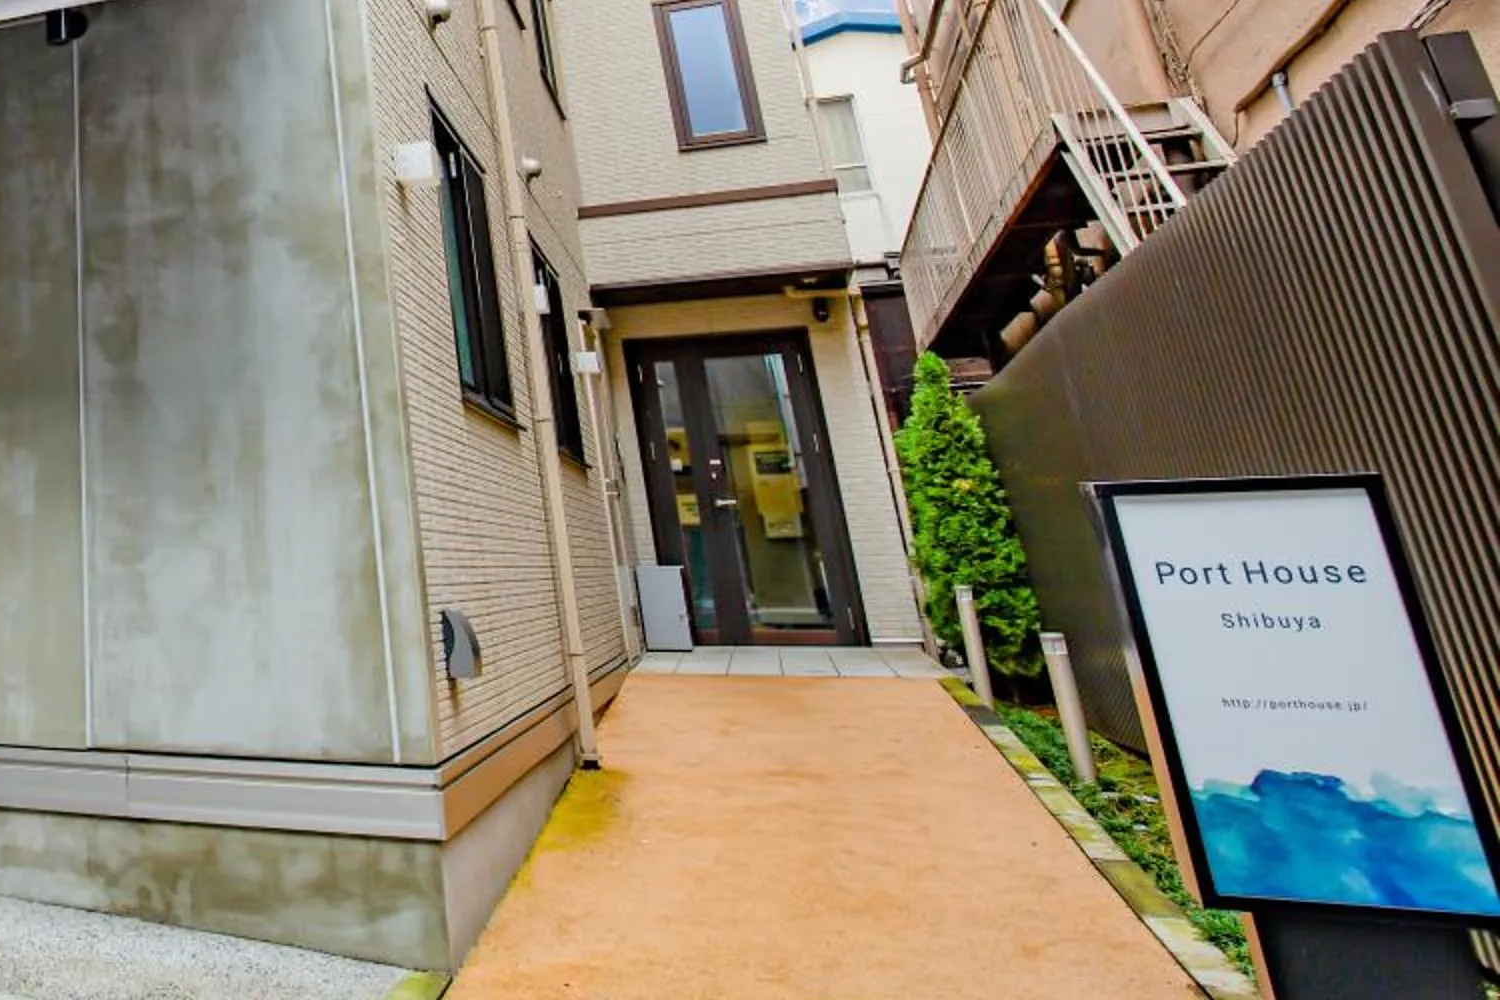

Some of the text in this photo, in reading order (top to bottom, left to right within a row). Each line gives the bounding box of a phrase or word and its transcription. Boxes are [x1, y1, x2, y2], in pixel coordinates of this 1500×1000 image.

[1155, 560, 1367, 585] Port House
[1220, 612, 1322, 632] Shibuya
